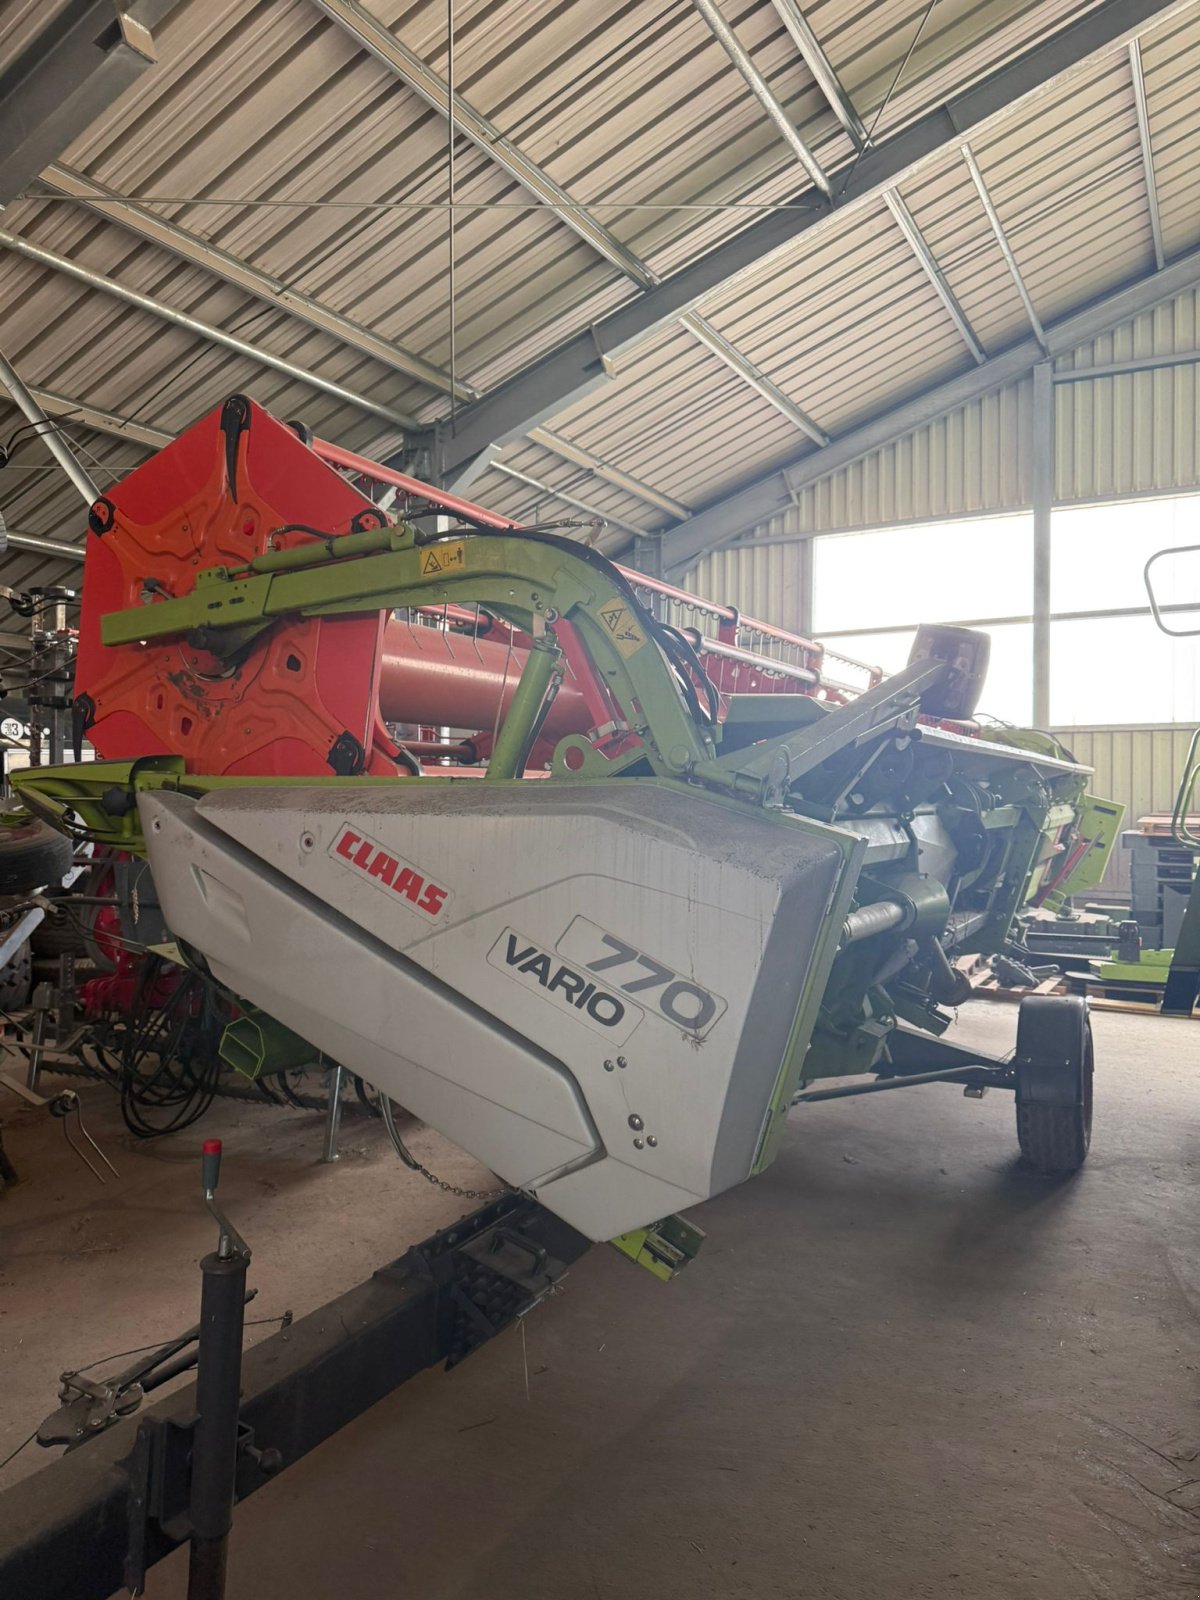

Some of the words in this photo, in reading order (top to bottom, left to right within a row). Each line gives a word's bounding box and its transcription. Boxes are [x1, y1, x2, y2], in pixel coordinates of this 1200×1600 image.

[336, 832, 447, 915] CLAAS
[506, 934, 625, 1027] VARIO
[585, 934, 716, 1029] 770
